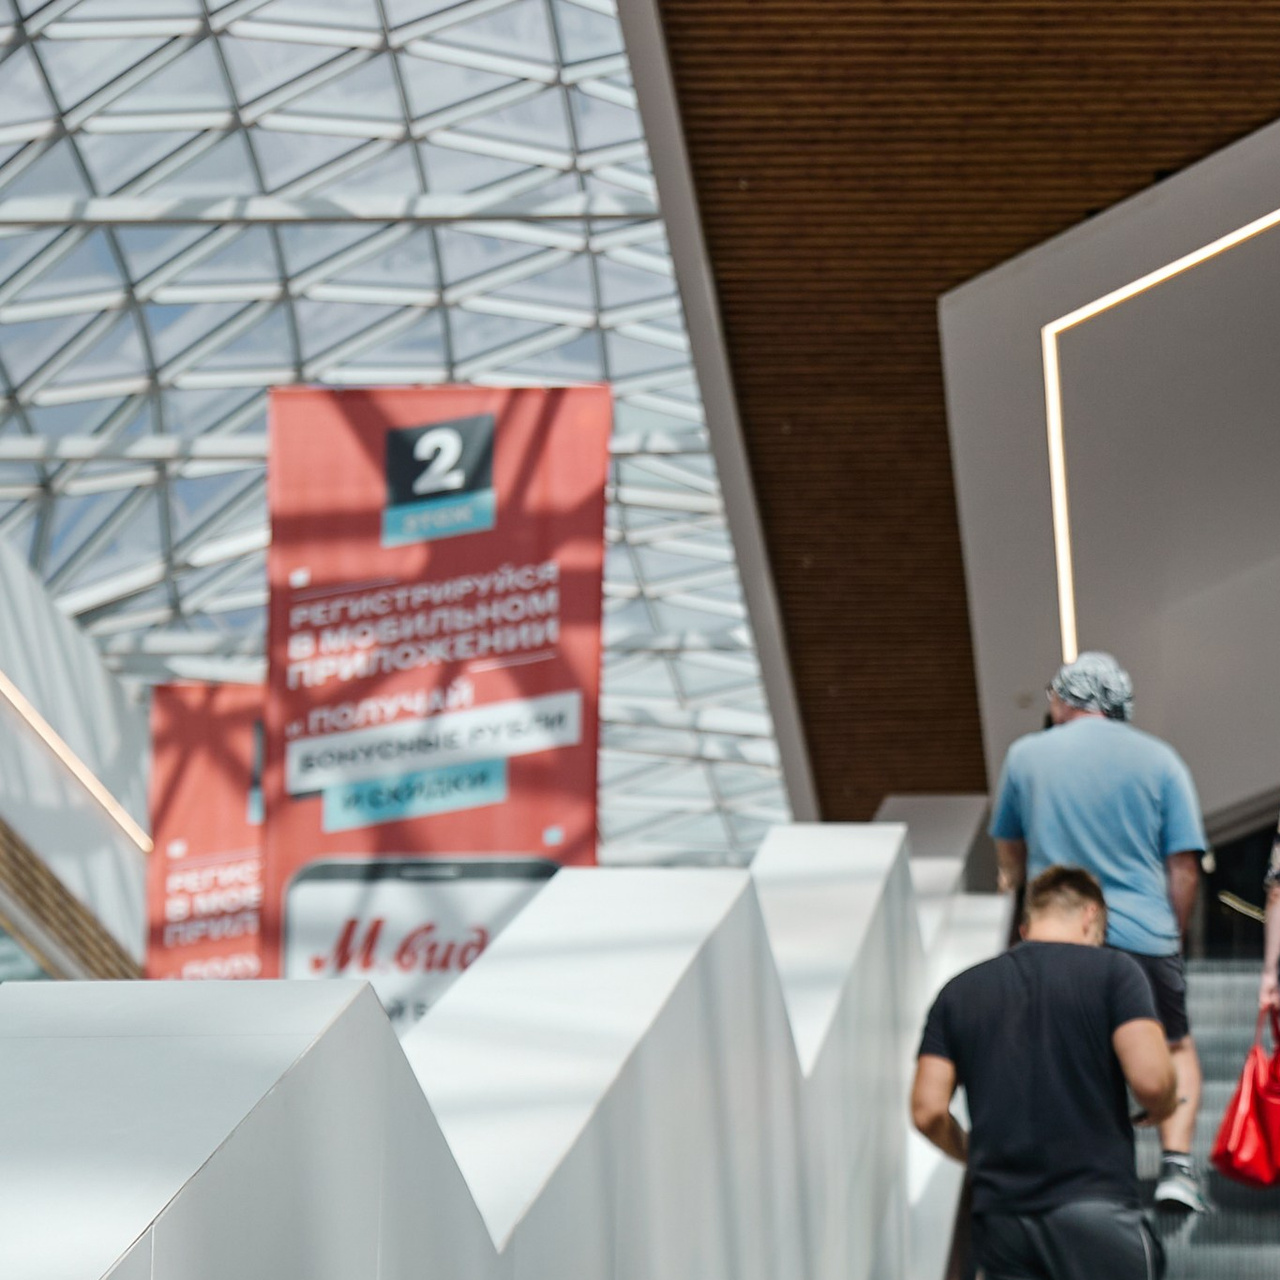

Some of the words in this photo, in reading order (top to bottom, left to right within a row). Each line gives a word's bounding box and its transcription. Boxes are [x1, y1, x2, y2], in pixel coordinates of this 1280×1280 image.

[412, 427, 465, 496] 2
[289, 559, 560, 629] РЕГИСТРИРУЙСЯ
[319, 586, 560, 654] МОБИЛЬНОМ
[287, 617, 559, 690] ПРИЛОЖЕНИИ
[308, 676, 475, 735] ПОЛУЧАЙ
[299, 731, 459, 773] БОНУСНЫЕ
[468, 710, 568, 749] РУБЛИ
[368, 769, 492, 808] СКИДКИ
